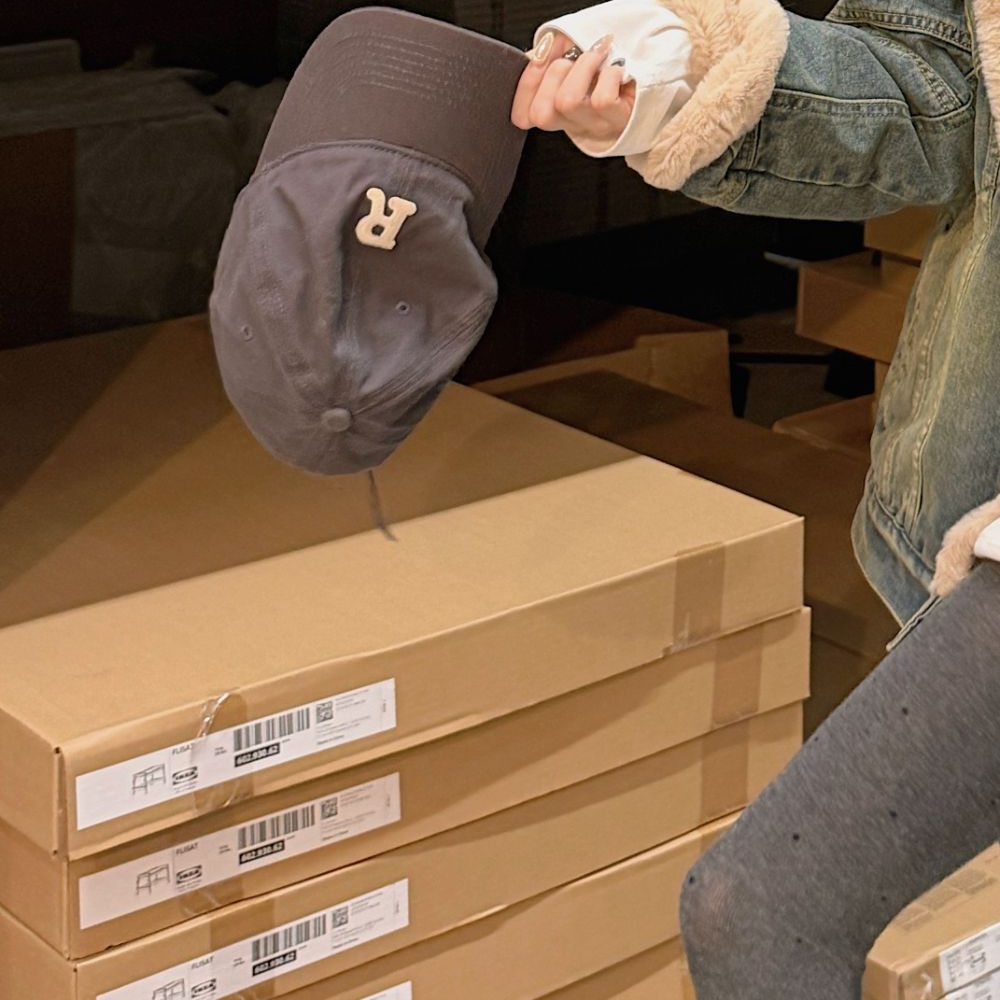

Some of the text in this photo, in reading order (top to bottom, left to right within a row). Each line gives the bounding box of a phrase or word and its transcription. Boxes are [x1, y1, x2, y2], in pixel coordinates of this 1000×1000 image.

[355, 187, 417, 250] R
[176, 842, 198, 855] FLISAT
[191, 956, 214, 969] FLISAT
